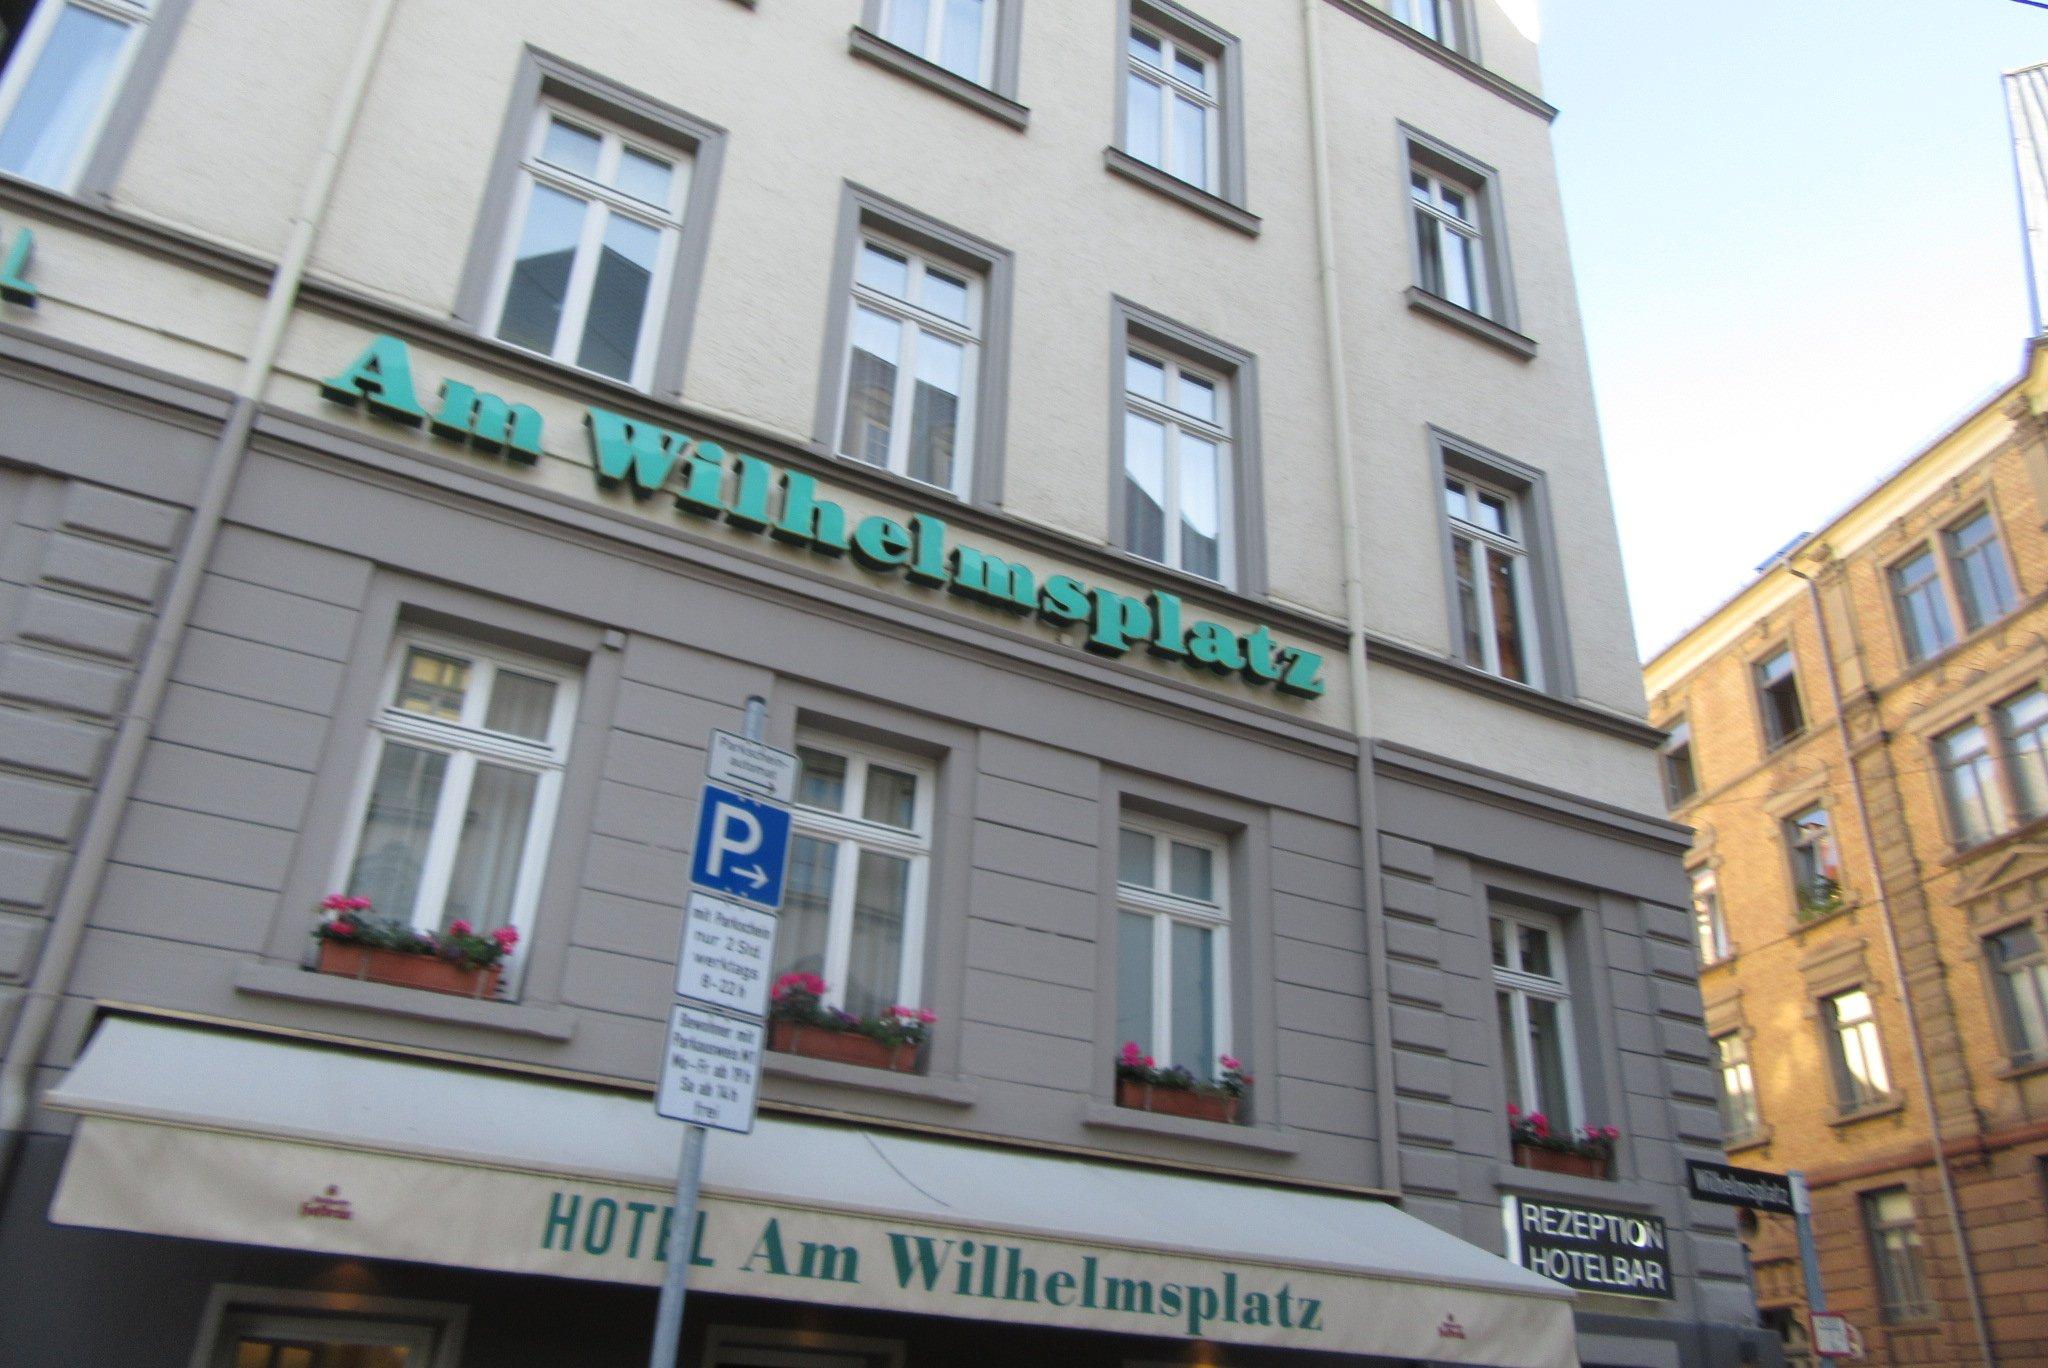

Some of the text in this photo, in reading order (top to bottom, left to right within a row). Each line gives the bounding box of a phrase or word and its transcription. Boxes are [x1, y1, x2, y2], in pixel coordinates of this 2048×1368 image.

[320, 333, 1327, 702] Am Wilhelmsplatz
[705, 801, 764, 878] P
[694, 953, 760, 982] werktags
[1521, 1202, 1665, 1250] REZEPTION
[738, 1218, 861, 1285] Am
[887, 1232, 1323, 1336] Wilhelmsplatz
[1528, 1245, 1668, 1291] HOTELBAR
